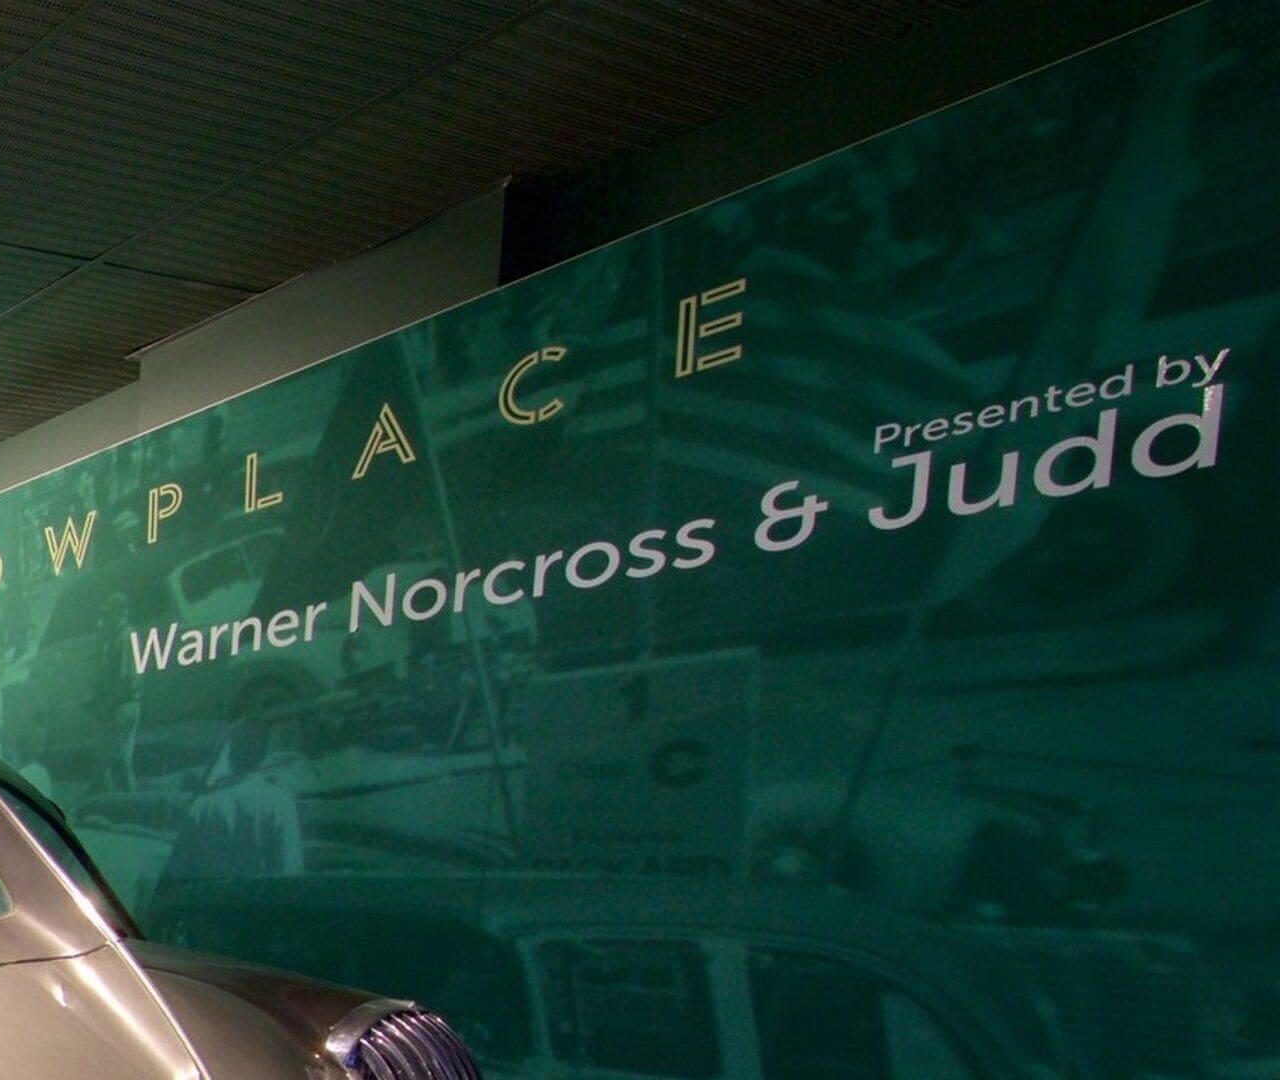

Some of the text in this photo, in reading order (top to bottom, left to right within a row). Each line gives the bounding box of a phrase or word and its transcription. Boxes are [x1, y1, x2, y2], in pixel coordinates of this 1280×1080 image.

[874, 348, 1231, 454] Presented by
[129, 383, 1225, 675] Warner Norcross & Judd
